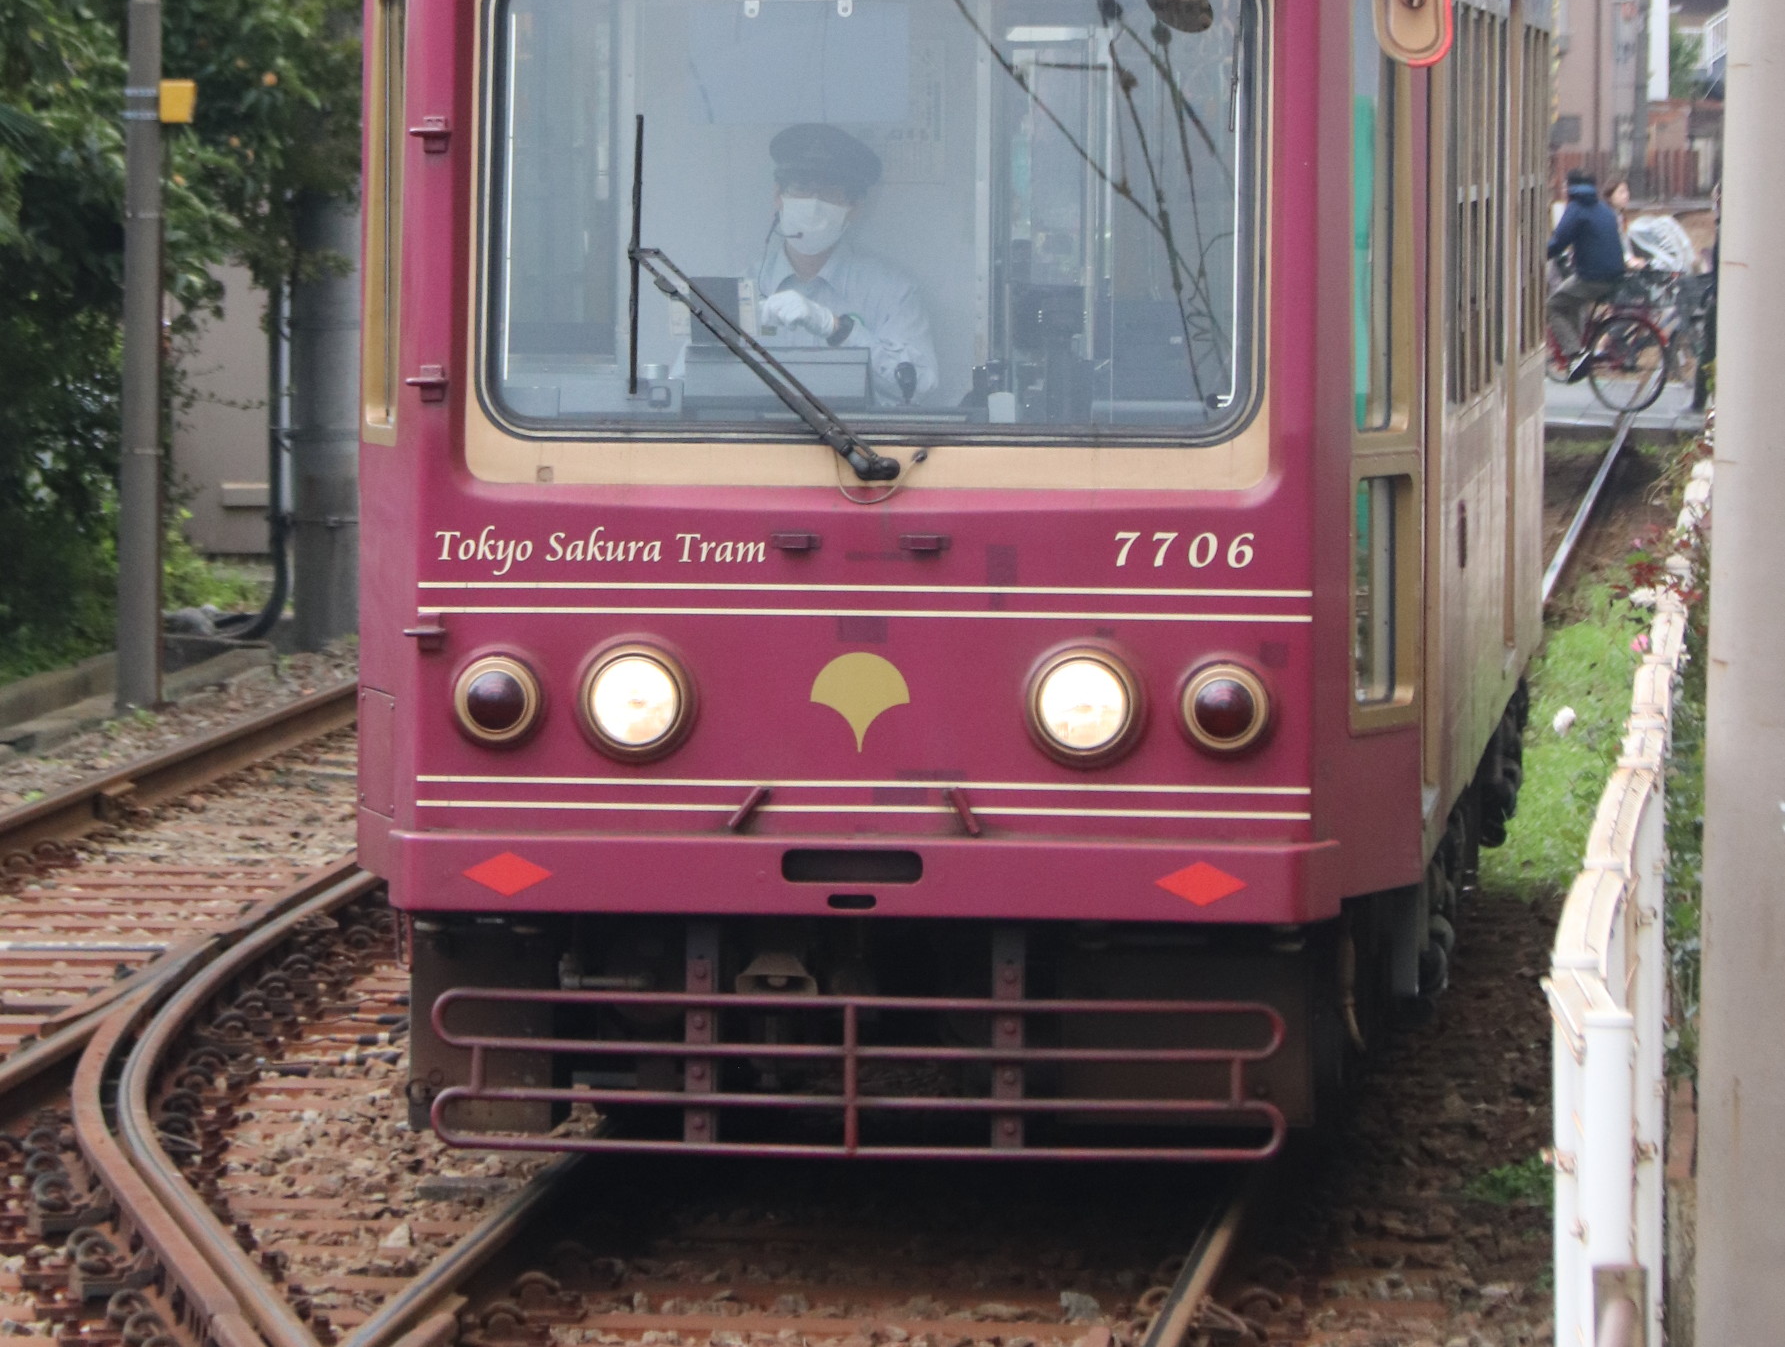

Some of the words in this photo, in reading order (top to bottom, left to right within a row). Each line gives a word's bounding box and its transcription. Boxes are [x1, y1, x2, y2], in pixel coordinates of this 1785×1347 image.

[435, 525, 533, 575] Tokyo
[545, 525, 662, 564] Sakura
[675, 528, 766, 564] Tram
[1114, 531, 1255, 569] 7706
